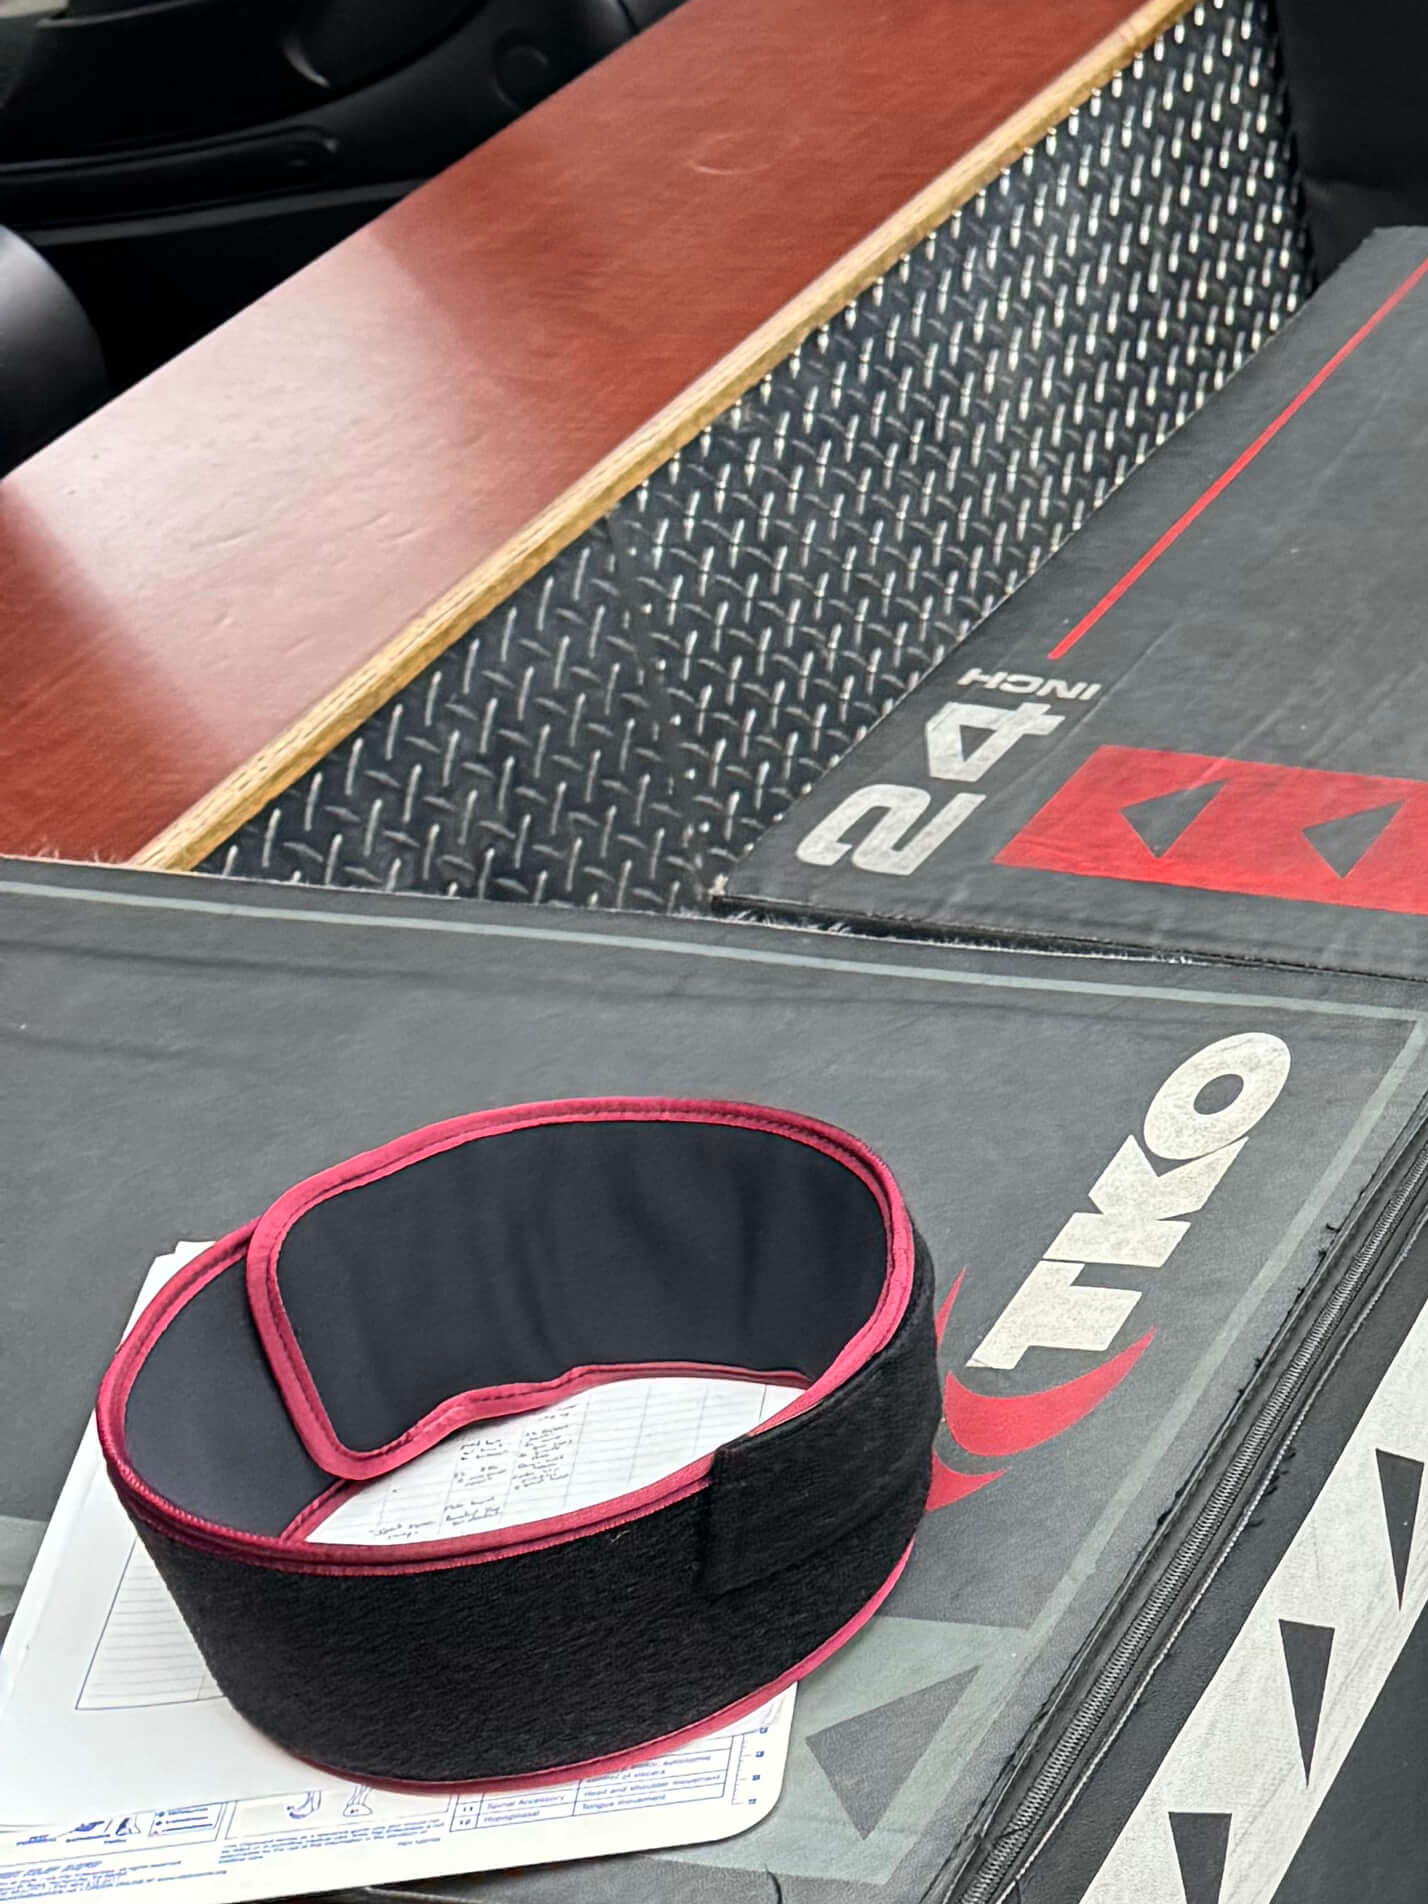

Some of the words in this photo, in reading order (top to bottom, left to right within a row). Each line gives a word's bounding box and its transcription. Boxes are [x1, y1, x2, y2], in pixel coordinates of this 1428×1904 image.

[956, 667, 1102, 701] INCH
[796, 701, 1067, 877] 24
[964, 1031, 1292, 1371] TKO
